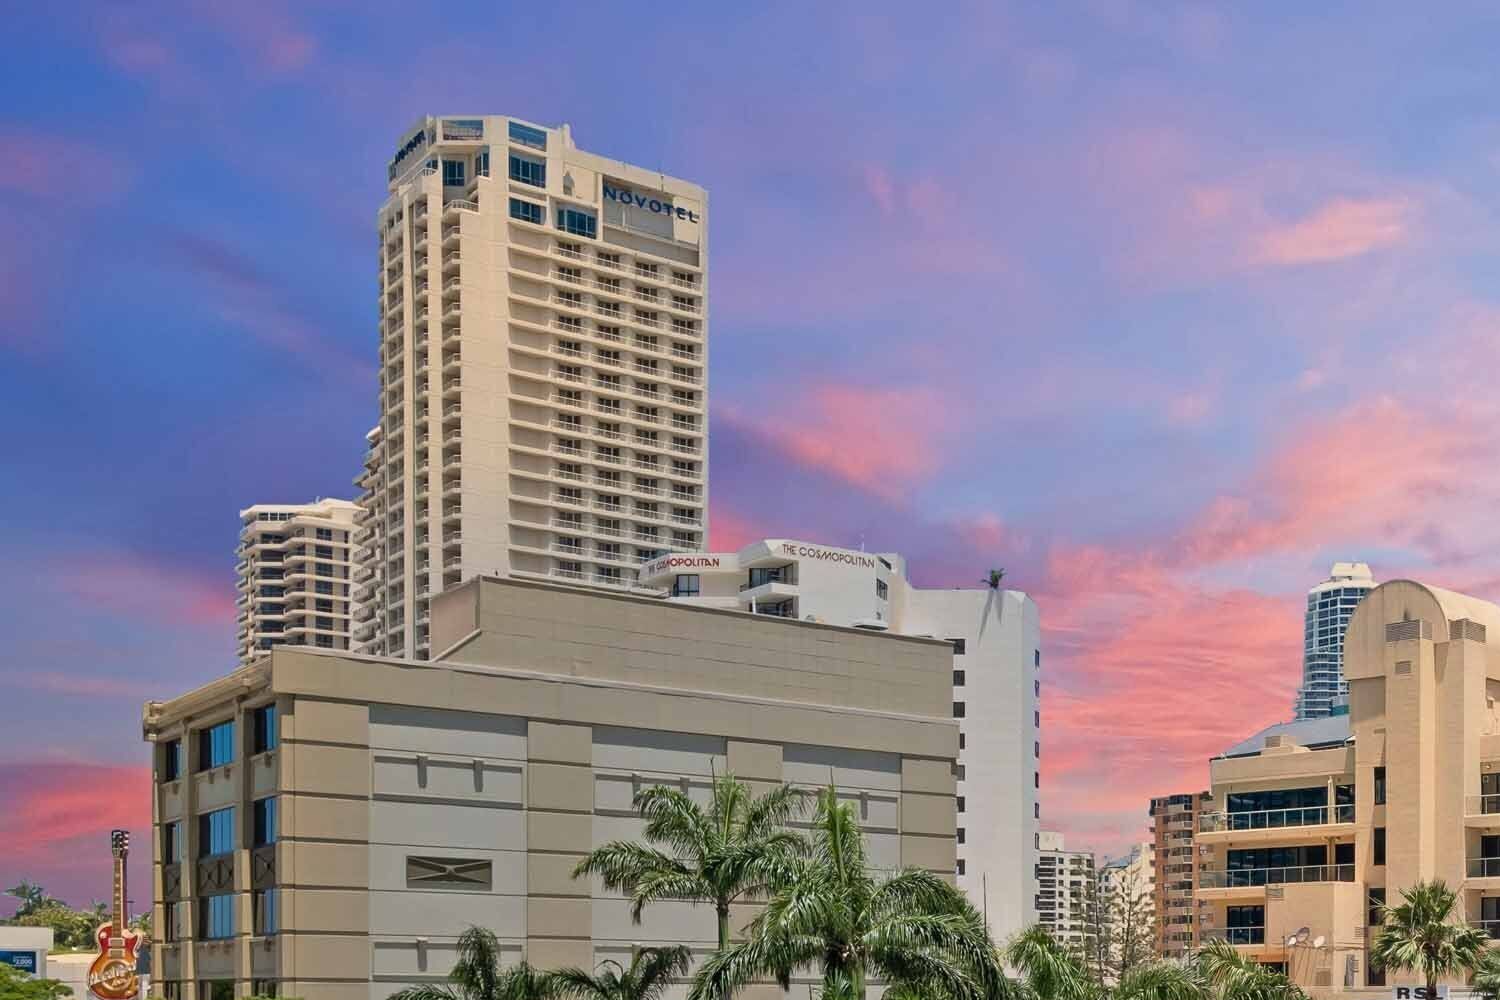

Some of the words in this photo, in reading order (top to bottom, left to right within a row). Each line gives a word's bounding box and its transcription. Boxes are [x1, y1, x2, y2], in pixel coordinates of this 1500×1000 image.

[603, 185, 699, 224] NOVOTEL
[782, 543, 797, 556] THE
[799, 546, 875, 569] COSMOPOLITAN
